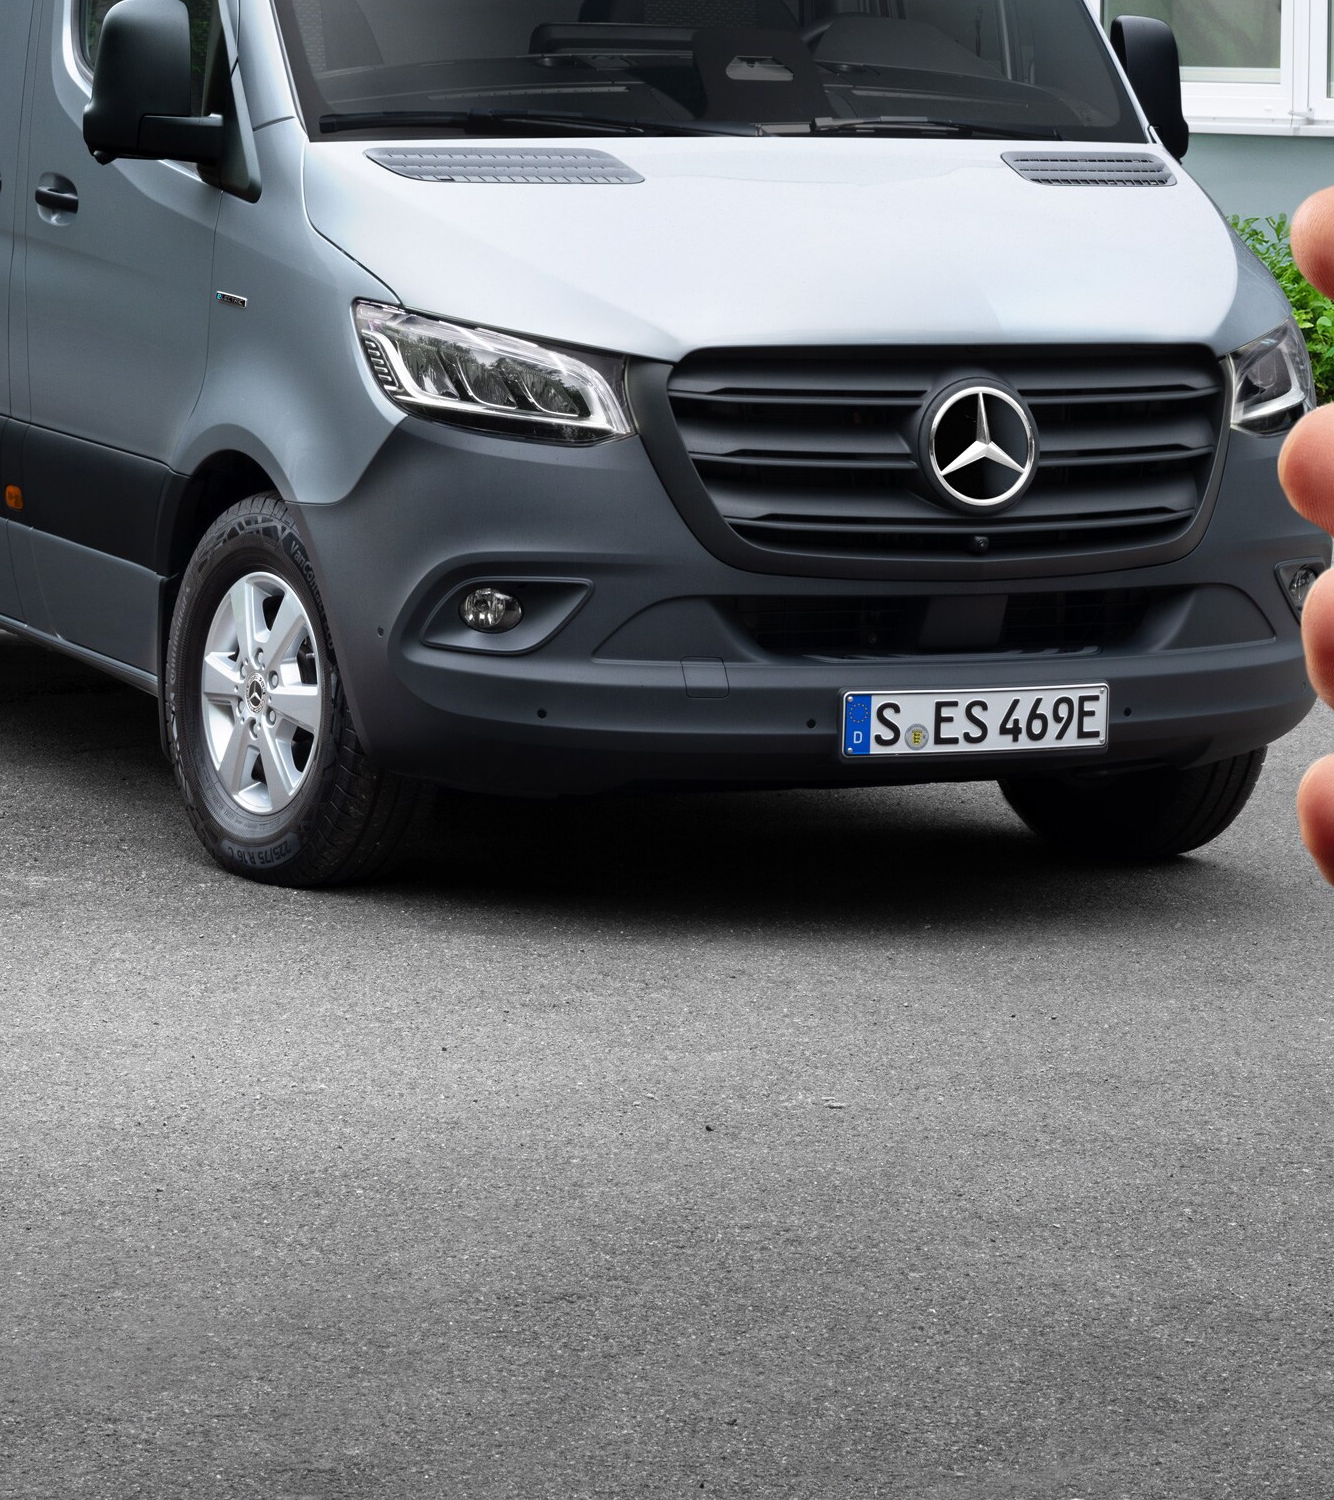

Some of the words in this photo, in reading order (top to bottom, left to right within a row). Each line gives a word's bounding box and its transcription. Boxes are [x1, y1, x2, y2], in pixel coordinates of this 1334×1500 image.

[853, 730, 863, 744] D
[874, 701, 901, 747] S
[933, 699, 989, 746] ES
[998, 694, 1101, 743] 469E
